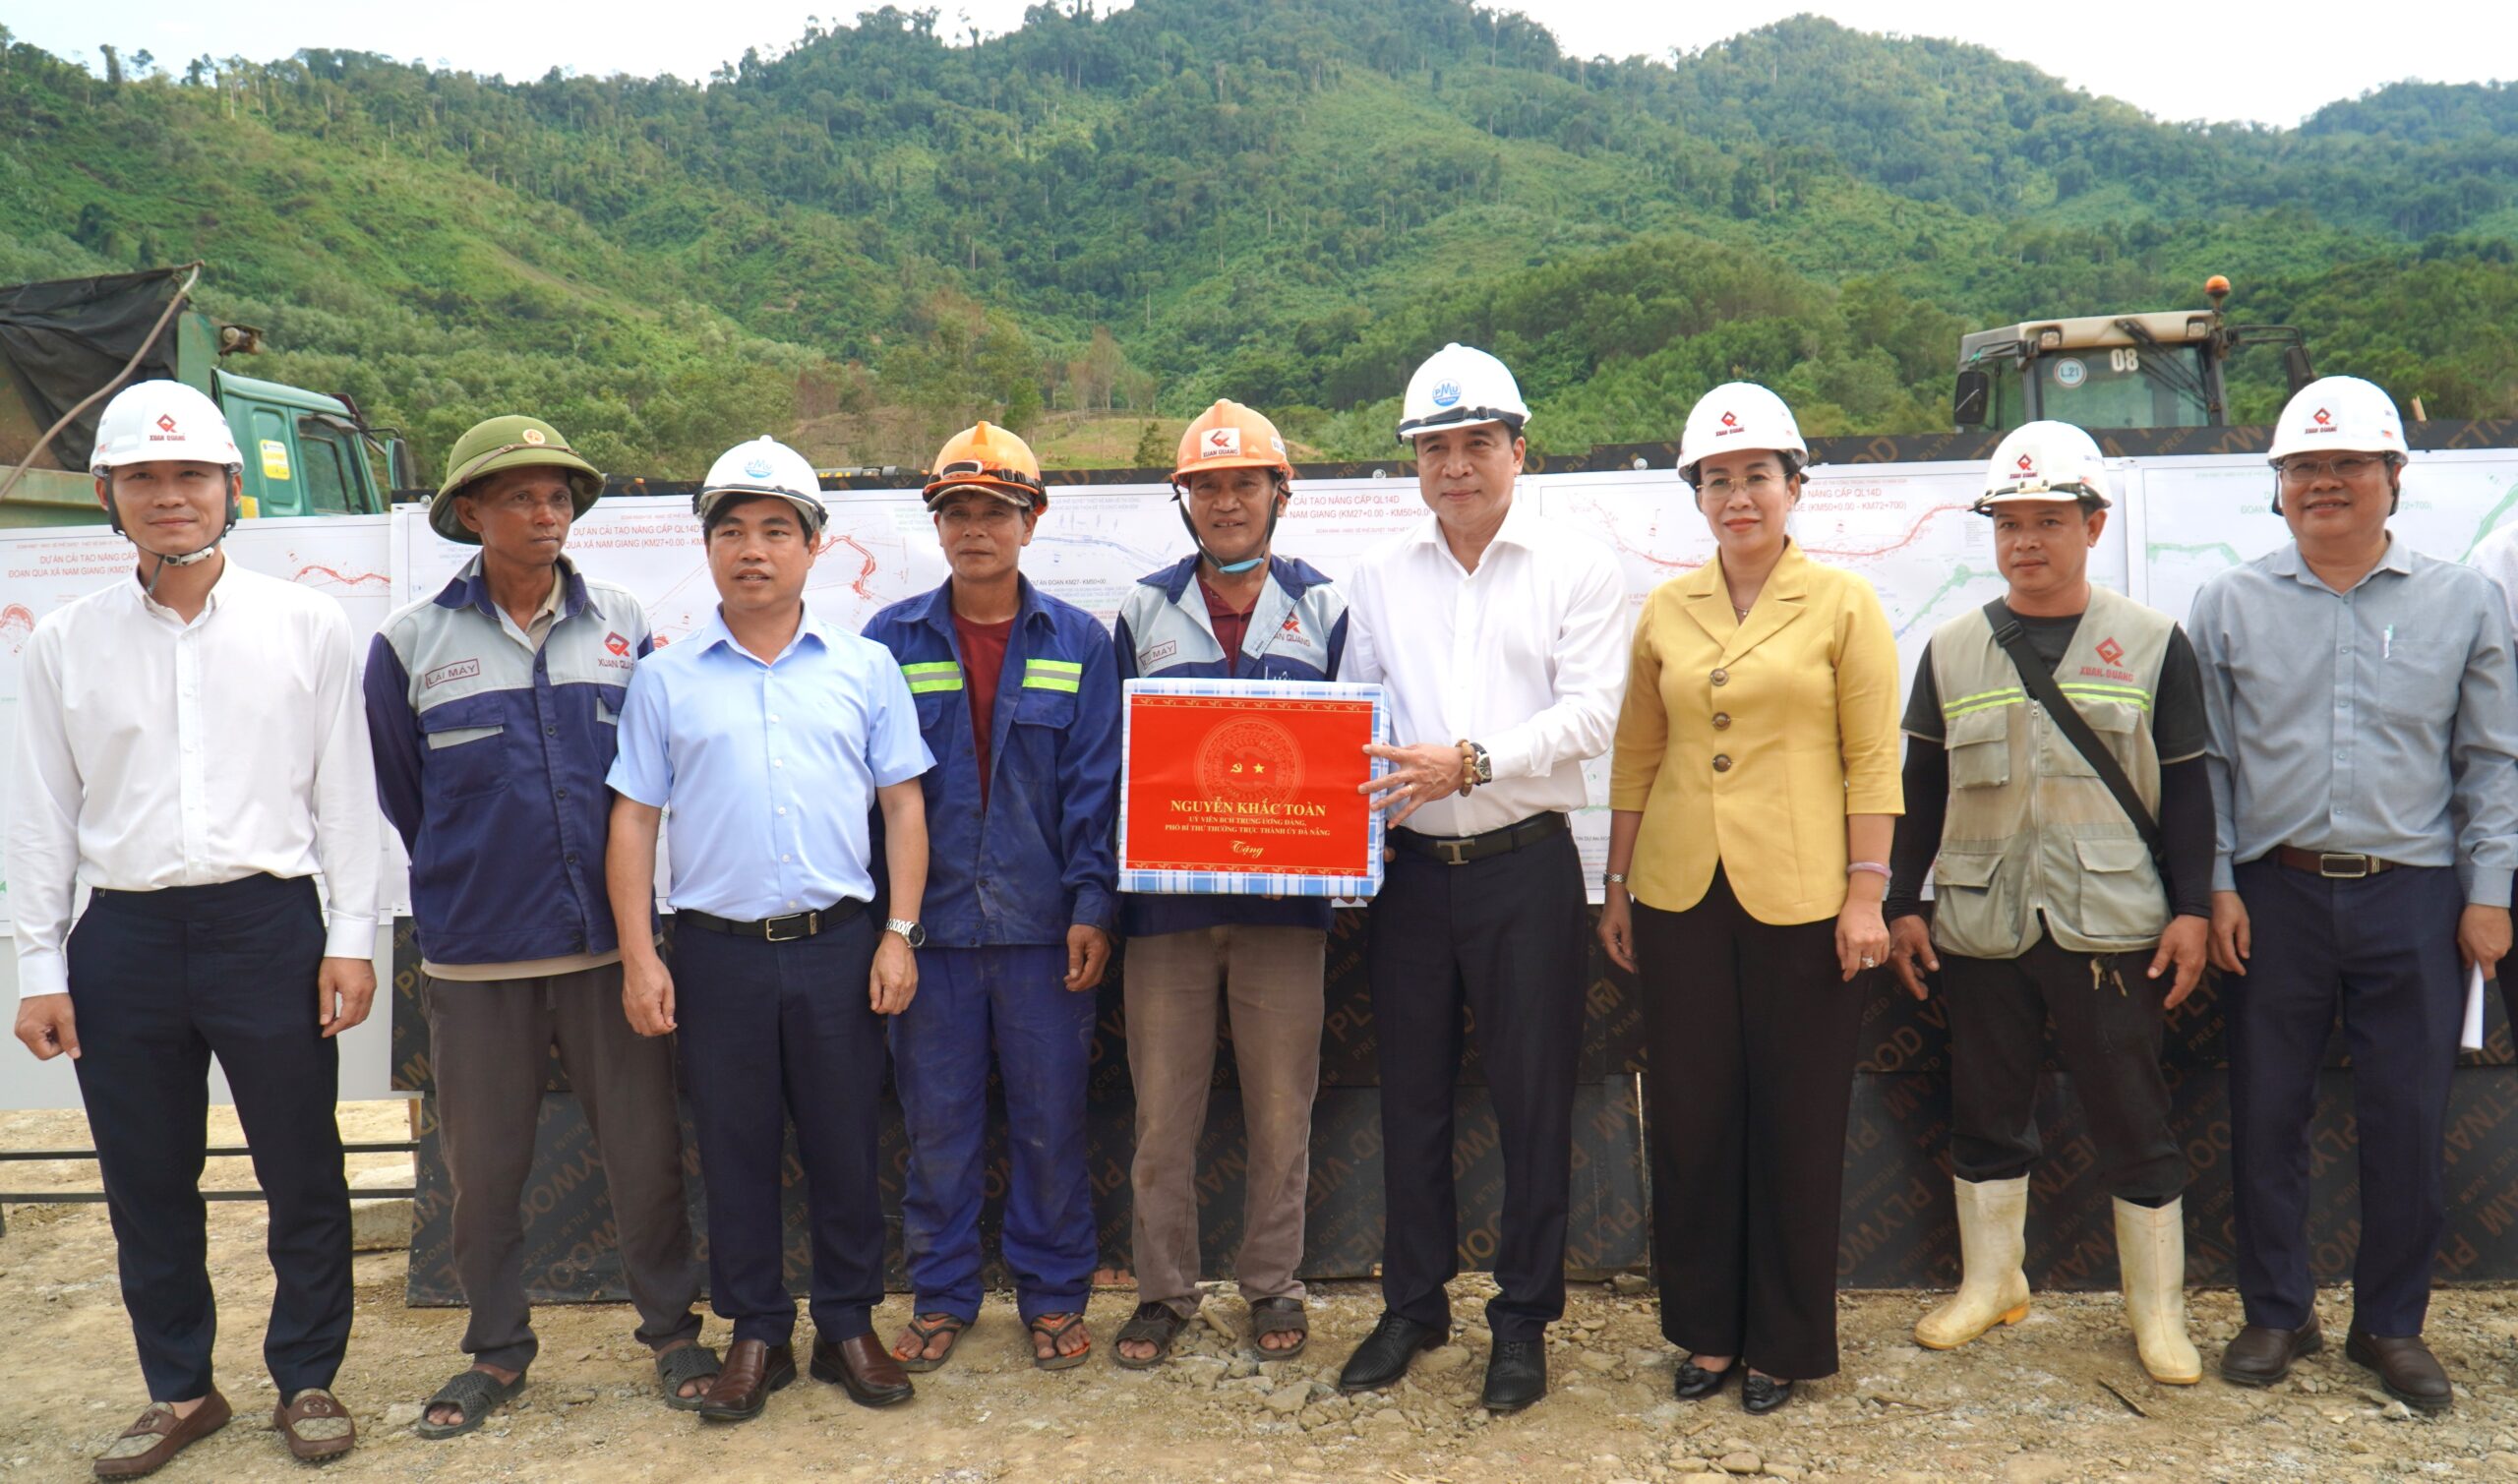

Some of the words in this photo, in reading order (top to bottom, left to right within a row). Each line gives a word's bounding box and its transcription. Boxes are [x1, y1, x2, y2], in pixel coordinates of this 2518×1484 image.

[2111, 348, 2139, 372] 08
[1373, 495, 1400, 505] QL14D
[674, 525, 700, 534] QL14D
[615, 539, 639, 548] GIANG
[1286, 634, 1311, 647] QUANG
[1170, 796, 1233, 813] NGUYỄN
[1237, 798, 1281, 815] KHẮC
[1284, 801, 1326, 817] TOÀN
